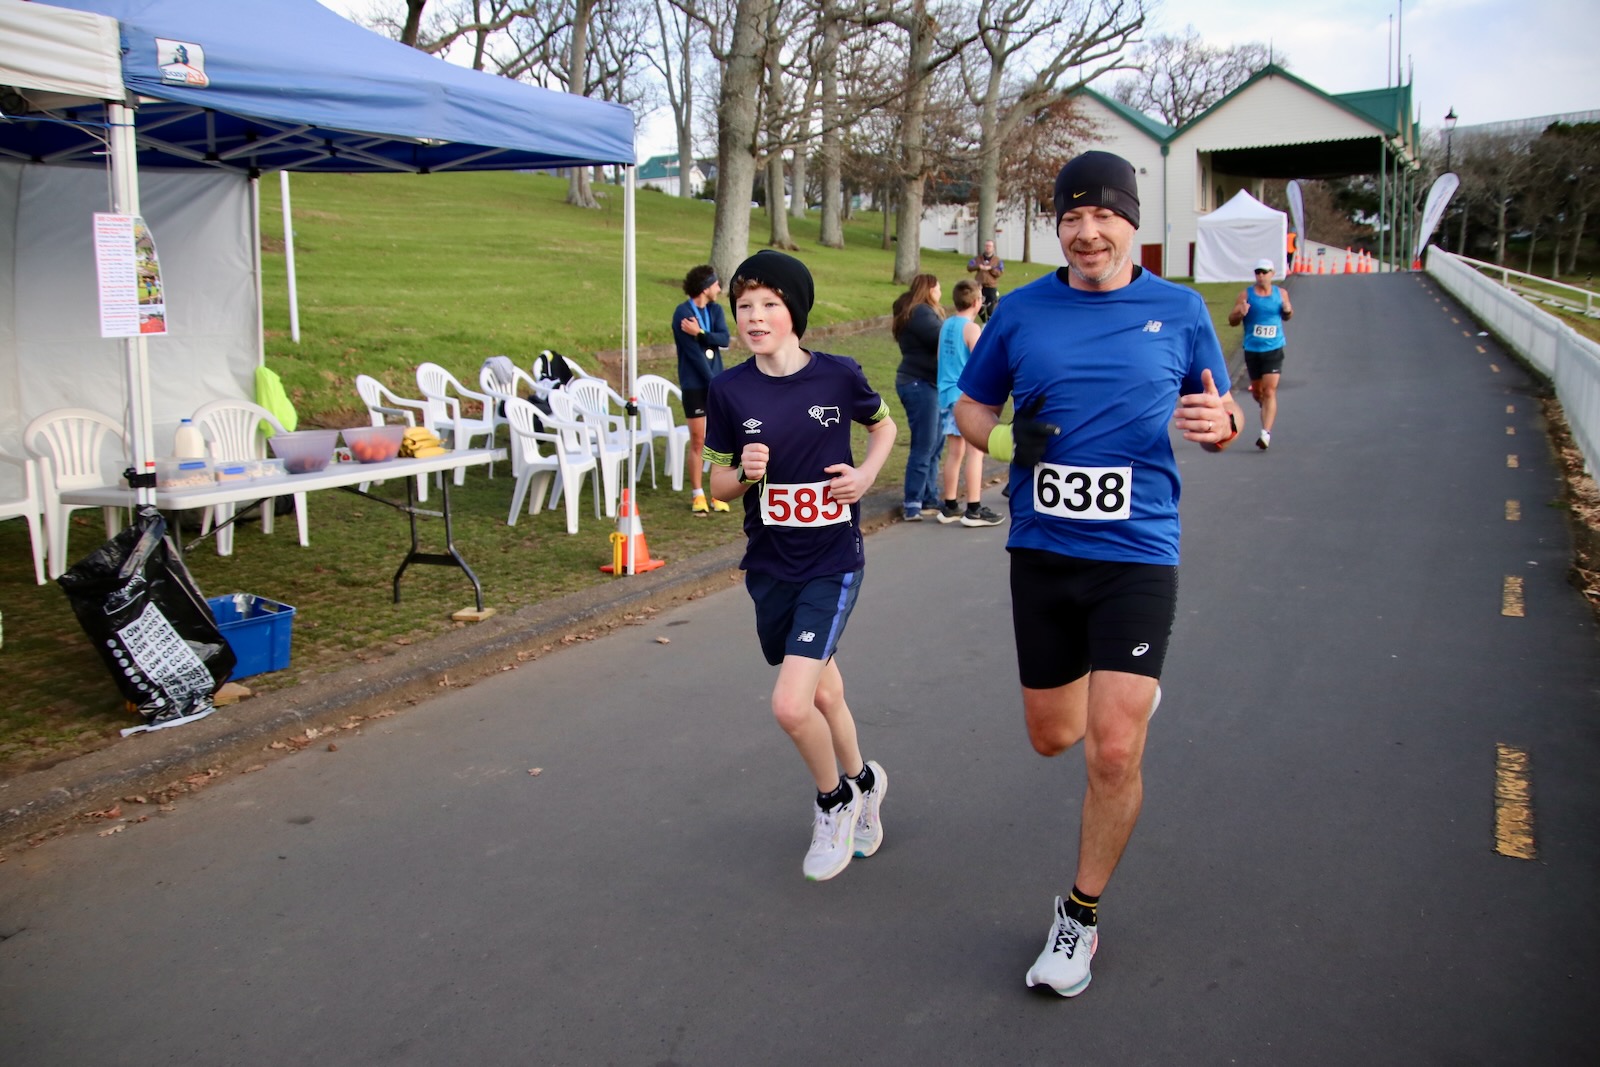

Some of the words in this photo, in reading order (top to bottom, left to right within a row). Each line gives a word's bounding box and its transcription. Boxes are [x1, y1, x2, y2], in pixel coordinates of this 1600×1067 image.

[1256, 326, 1275, 336] 618
[768, 488, 843, 523] 585
[1037, 468, 1125, 513] 638
[121, 625, 140, 639] LOW
[141, 606, 156, 626] COST
[127, 633, 144, 649] LOW
[144, 615, 163, 634] COST
[133, 642, 149, 657] LOW
[150, 624, 170, 642] COST
[138, 650, 156, 665] LOW
[155, 631, 176, 650] COST
[145, 657, 162, 673] LOW
[162, 639, 183, 658] COST
[152, 666, 169, 681] LOW
[170, 648, 191, 666] COST
[177, 656, 198, 674] COST
